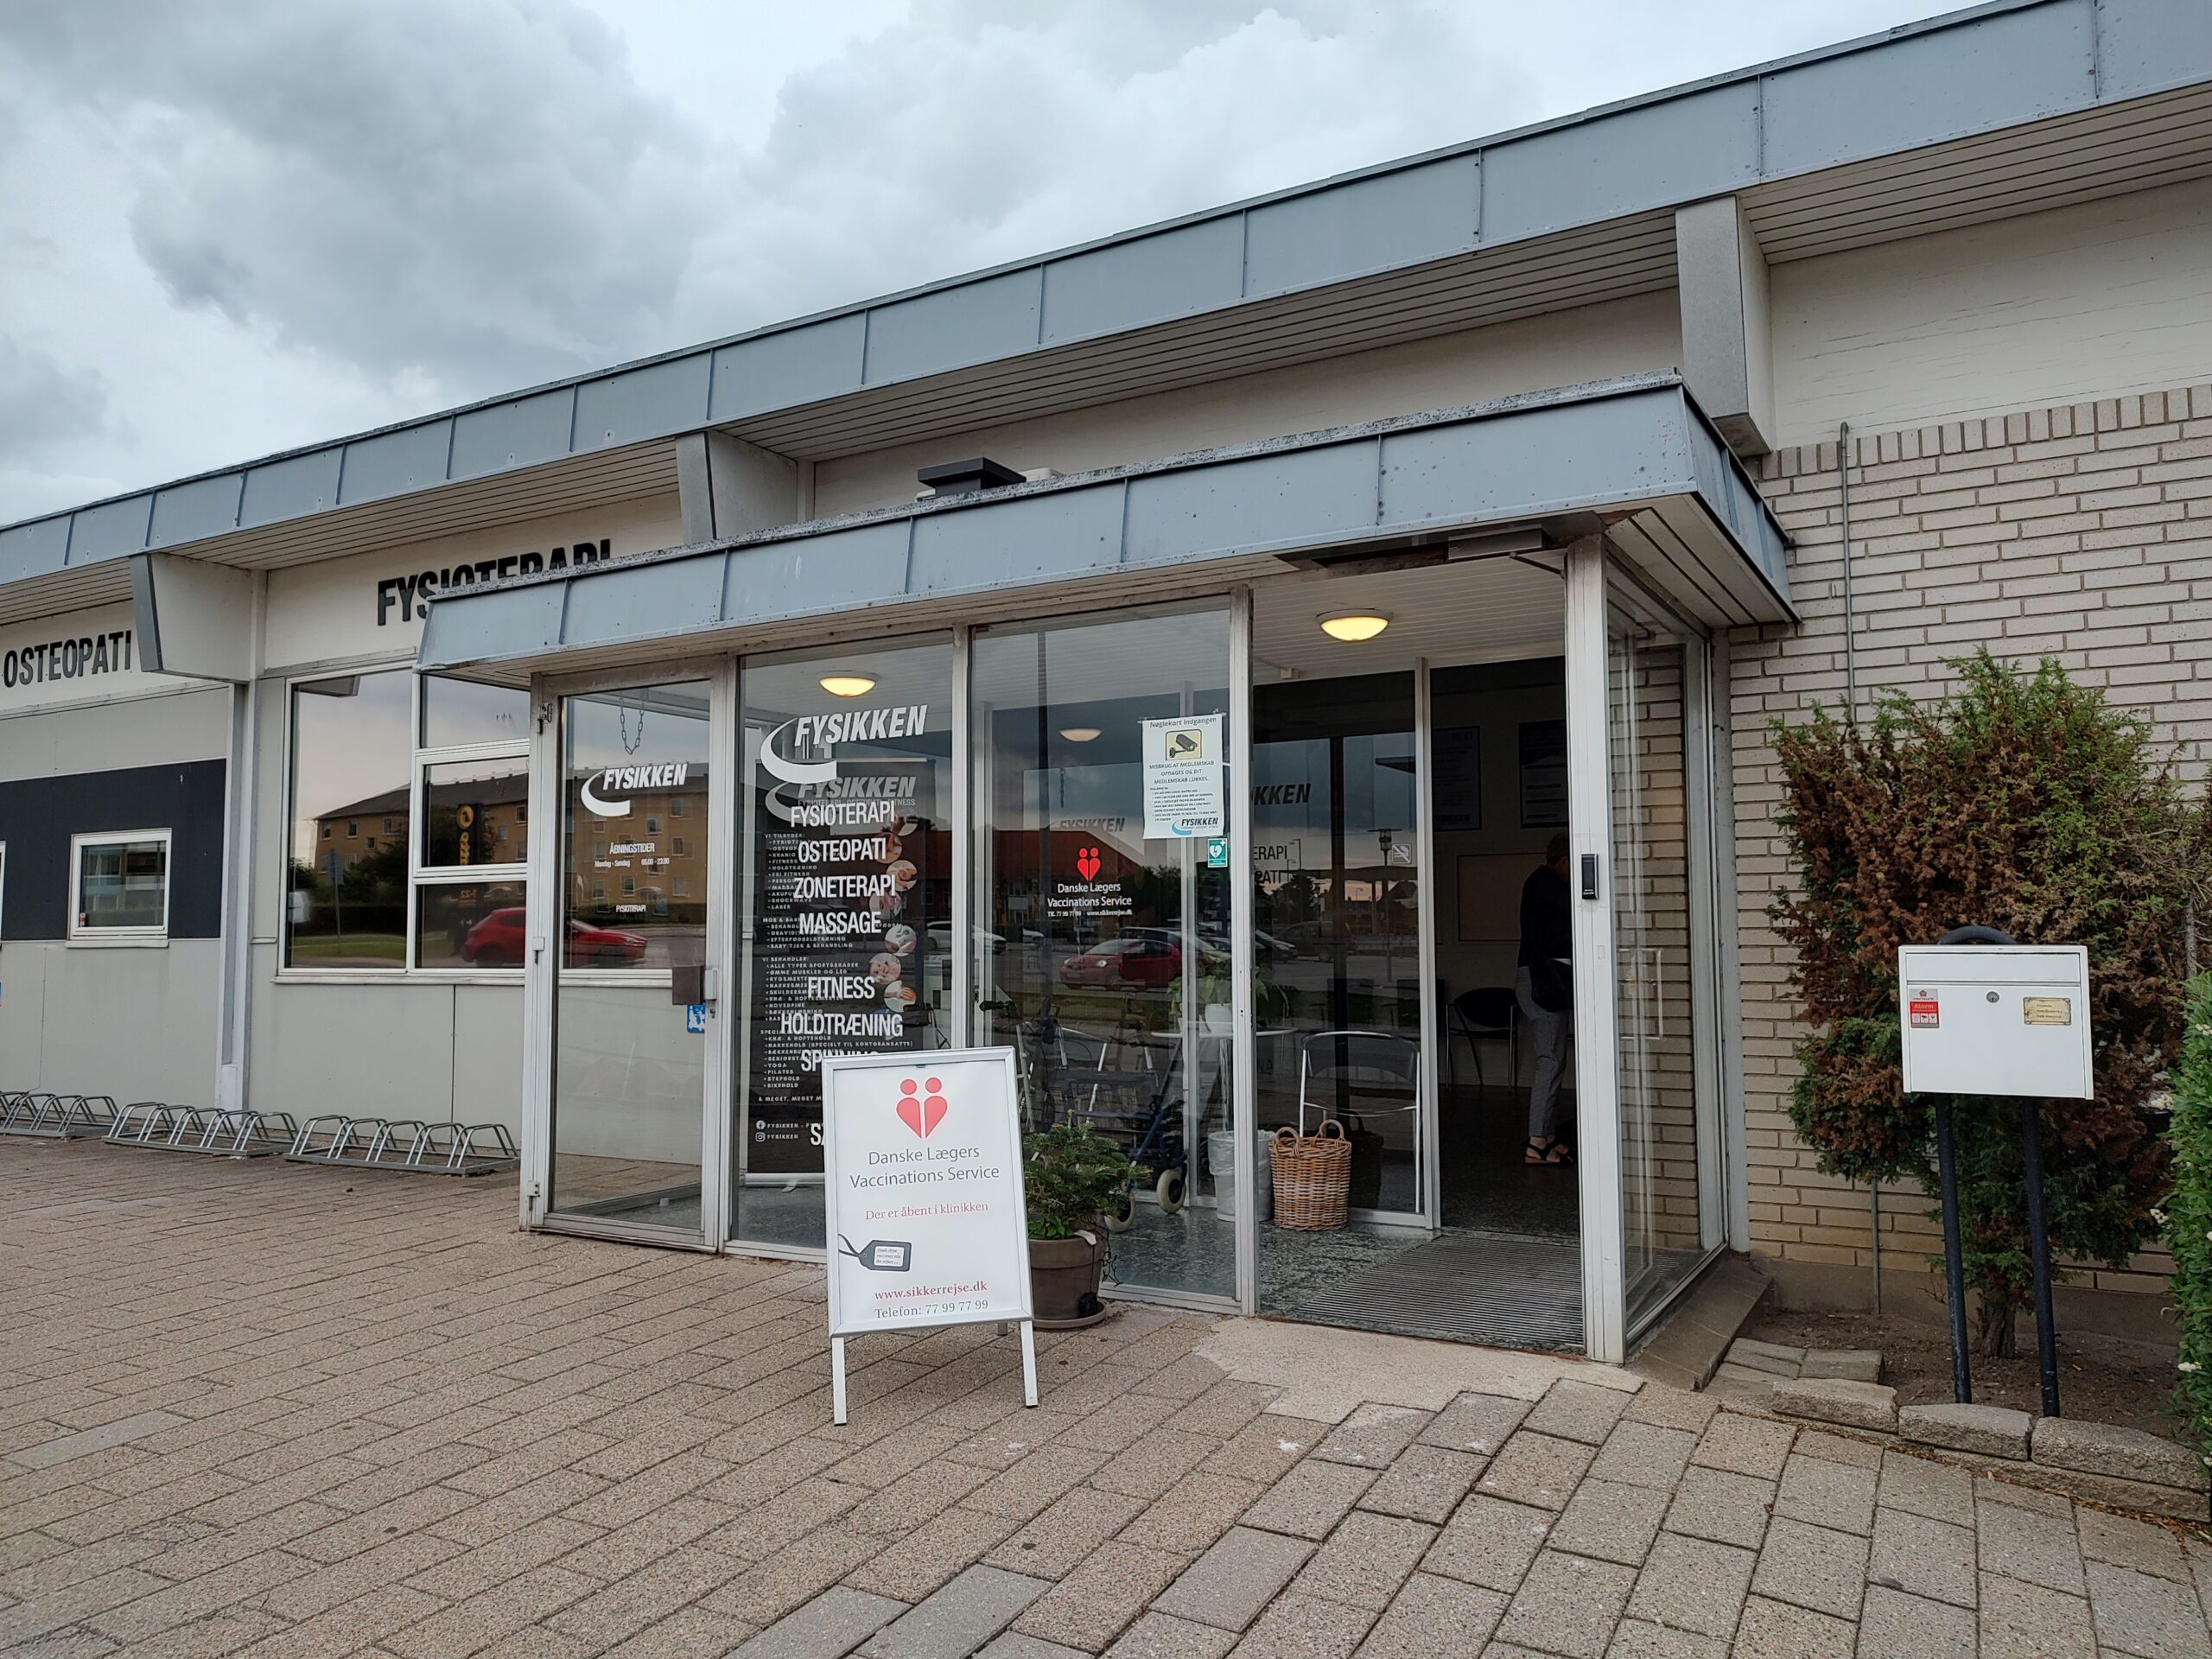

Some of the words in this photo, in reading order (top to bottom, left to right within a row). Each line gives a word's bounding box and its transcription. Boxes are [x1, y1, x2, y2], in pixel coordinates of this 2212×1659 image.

[3, 630, 132, 689] OSTEOPATI
[794, 704, 928, 747] FYSIKKEN
[1150, 720, 1182, 728] Nøglekort
[1184, 717, 1217, 726] Indgangen
[603, 764, 688, 791] FYSIKKEN
[798, 776, 916, 798] FYSIKKEN
[1253, 783, 1311, 805] KKEN
[791, 800, 895, 828] FYSIOTERAPI
[1181, 817, 1218, 827] FYSIKKEN
[609, 842, 655, 854] ÅBNINGSTIDER
[798, 837, 887, 863] OSTEOPATI
[793, 874, 896, 899] ZONETERAPI
[1058, 882, 1088, 893] Danske
[1090, 882, 1121, 893] Lægers
[1047, 897, 1099, 907] Vaccinations
[1101, 896, 1132, 906] Service
[799, 911, 881, 935] MASSAGE
[808, 976, 875, 1000] FITNESS
[781, 1013, 903, 1037] HOLDTRÆNING
[868, 1148, 923, 1165] Danske
[927, 1147, 980, 1162] Lægers
[850, 1170, 944, 1188] Vaccinations
[948, 1166, 1000, 1180] Service
[866, 1210, 886, 1220] Der
[888, 1210, 899, 1218] er
[901, 1205, 931, 1217] åbent
[934, 1205, 938, 1214] i
[940, 1202, 988, 1214] klinikken
[874, 1281, 988, 1300] www.sikkerrejse.dk
[874, 1306, 922, 1319] Telefon:
[925, 1304, 938, 1313] 77
[942, 1302, 955, 1313] 99
[959, 1301, 972, 1311] 77
[975, 1300, 988, 1309] 99
